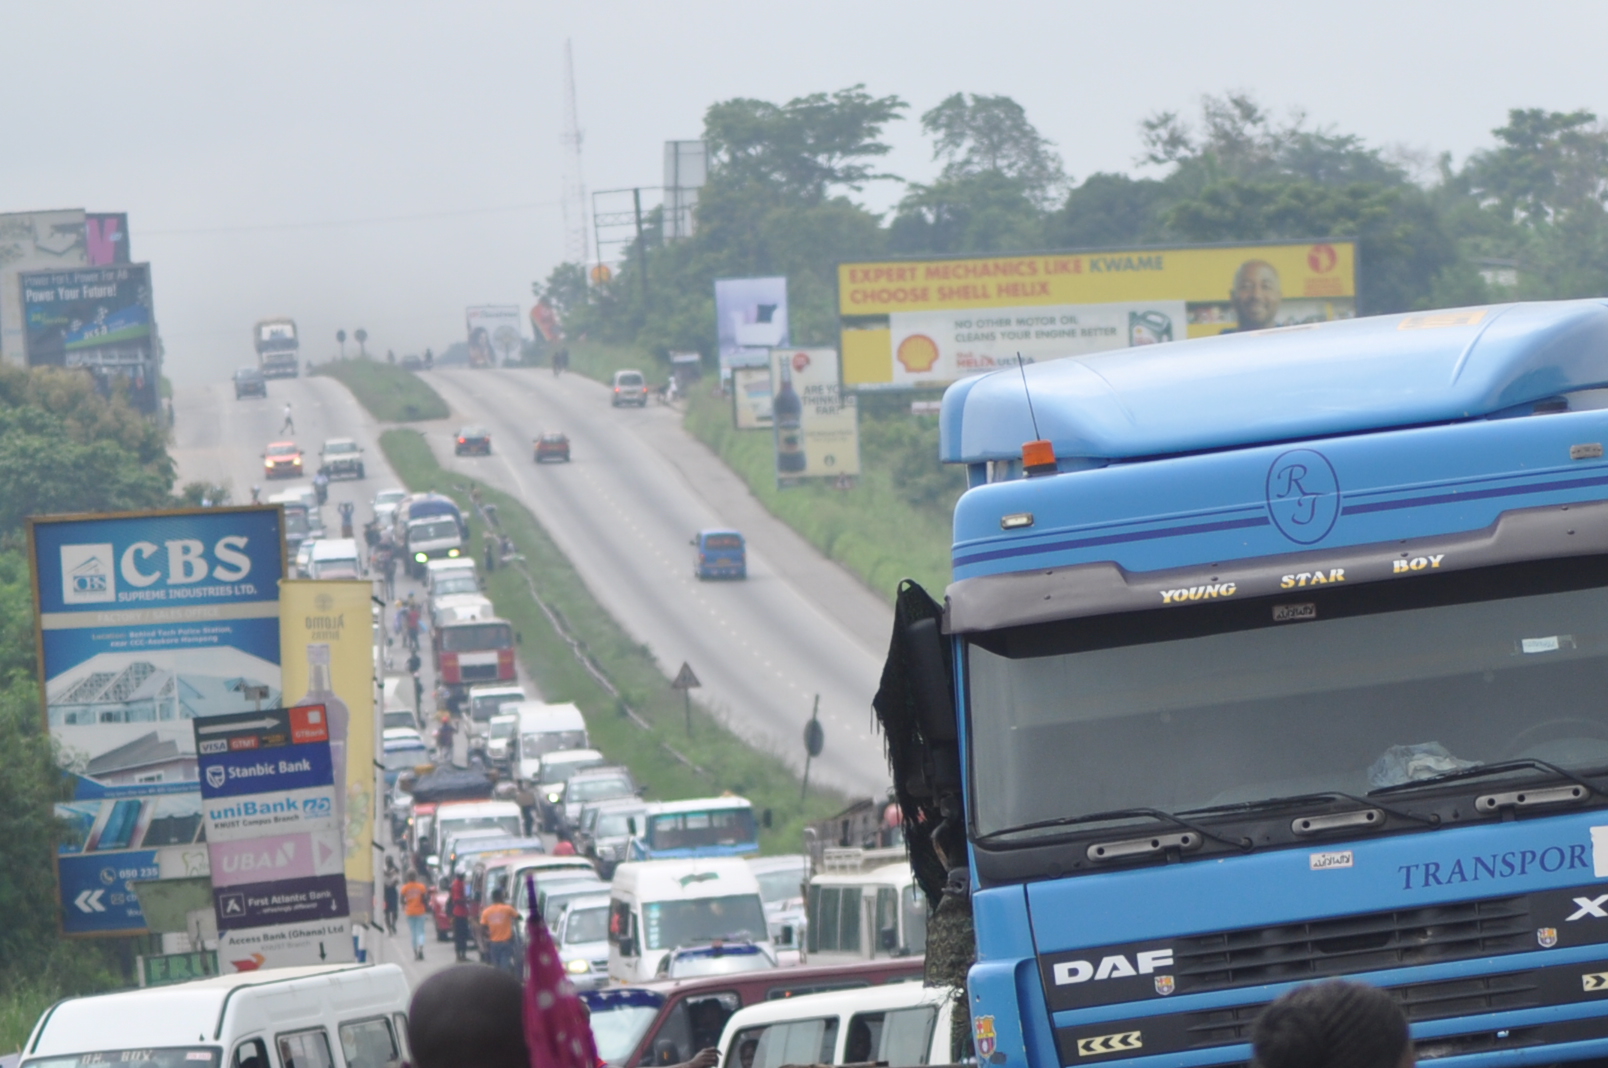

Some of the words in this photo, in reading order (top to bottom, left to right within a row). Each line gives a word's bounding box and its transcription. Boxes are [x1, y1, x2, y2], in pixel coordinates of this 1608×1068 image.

[850, 267, 917, 283] EXPERT
[925, 260, 1037, 281] MECHANICS
[1044, 259, 1083, 275] LIKE
[1090, 256, 1164, 272] KWAME
[26, 289, 54, 303] Power
[58, 287, 80, 301] Your
[83, 284, 117, 298] Future!
[850, 288, 929, 304] CHOOSE
[938, 284, 991, 300] SHELL
[997, 281, 1051, 298] HELIX
[955, 320, 973, 330] NO
[976, 317, 1012, 328] OTHER
[1016, 316, 1057, 327] MOTOR
[1060, 315, 1079, 326] OIL
[955, 332, 996, 343] CLEANS
[1000, 330, 1031, 341] YOUR
[1035, 328, 1077, 340] ENGINE
[1080, 326, 1117, 338] BETTER
[804, 384, 825, 396] ARE
[120, 535, 252, 588] CBS
[73, 575, 107, 592] CBS
[1160, 581, 1238, 605] YOUNG
[1280, 567, 1346, 590] STAR
[1392, 553, 1445, 574] BOY
[118, 589, 167, 602] SUPREME
[169, 586, 233, 599] INDUSTRIES
[235, 584, 258, 596] LTD.
[98, 612, 141, 623] FACTORY
[153, 609, 182, 620] SALES
[186, 607, 220, 618] OFFICE
[129, 630, 156, 639] Behind
[158, 629, 176, 637] Tech
[295, 728, 325, 739] GTBank
[202, 741, 227, 751] VISA
[228, 763, 275, 780] Stanbic
[278, 758, 311, 774] Bank
[210, 797, 299, 821] uniBank
[214, 820, 240, 830] KNUST
[242, 817, 272, 829] Campus
[274, 814, 300, 824] Branch
[222, 851, 272, 873] UBA
[1399, 843, 1591, 891] TRANSPOR
[119, 868, 138, 879] 050
[140, 866, 158, 877] 235
[248, 897, 269, 908] First
[271, 893, 307, 906] Atlantic
[309, 890, 332, 901] Bank
[229, 935, 261, 947] Access
[263, 931, 287, 942] Bank
[289, 927, 326, 940] (Ghana)
[328, 925, 344, 935] Ltd
[1052, 948, 1174, 986] DAF
